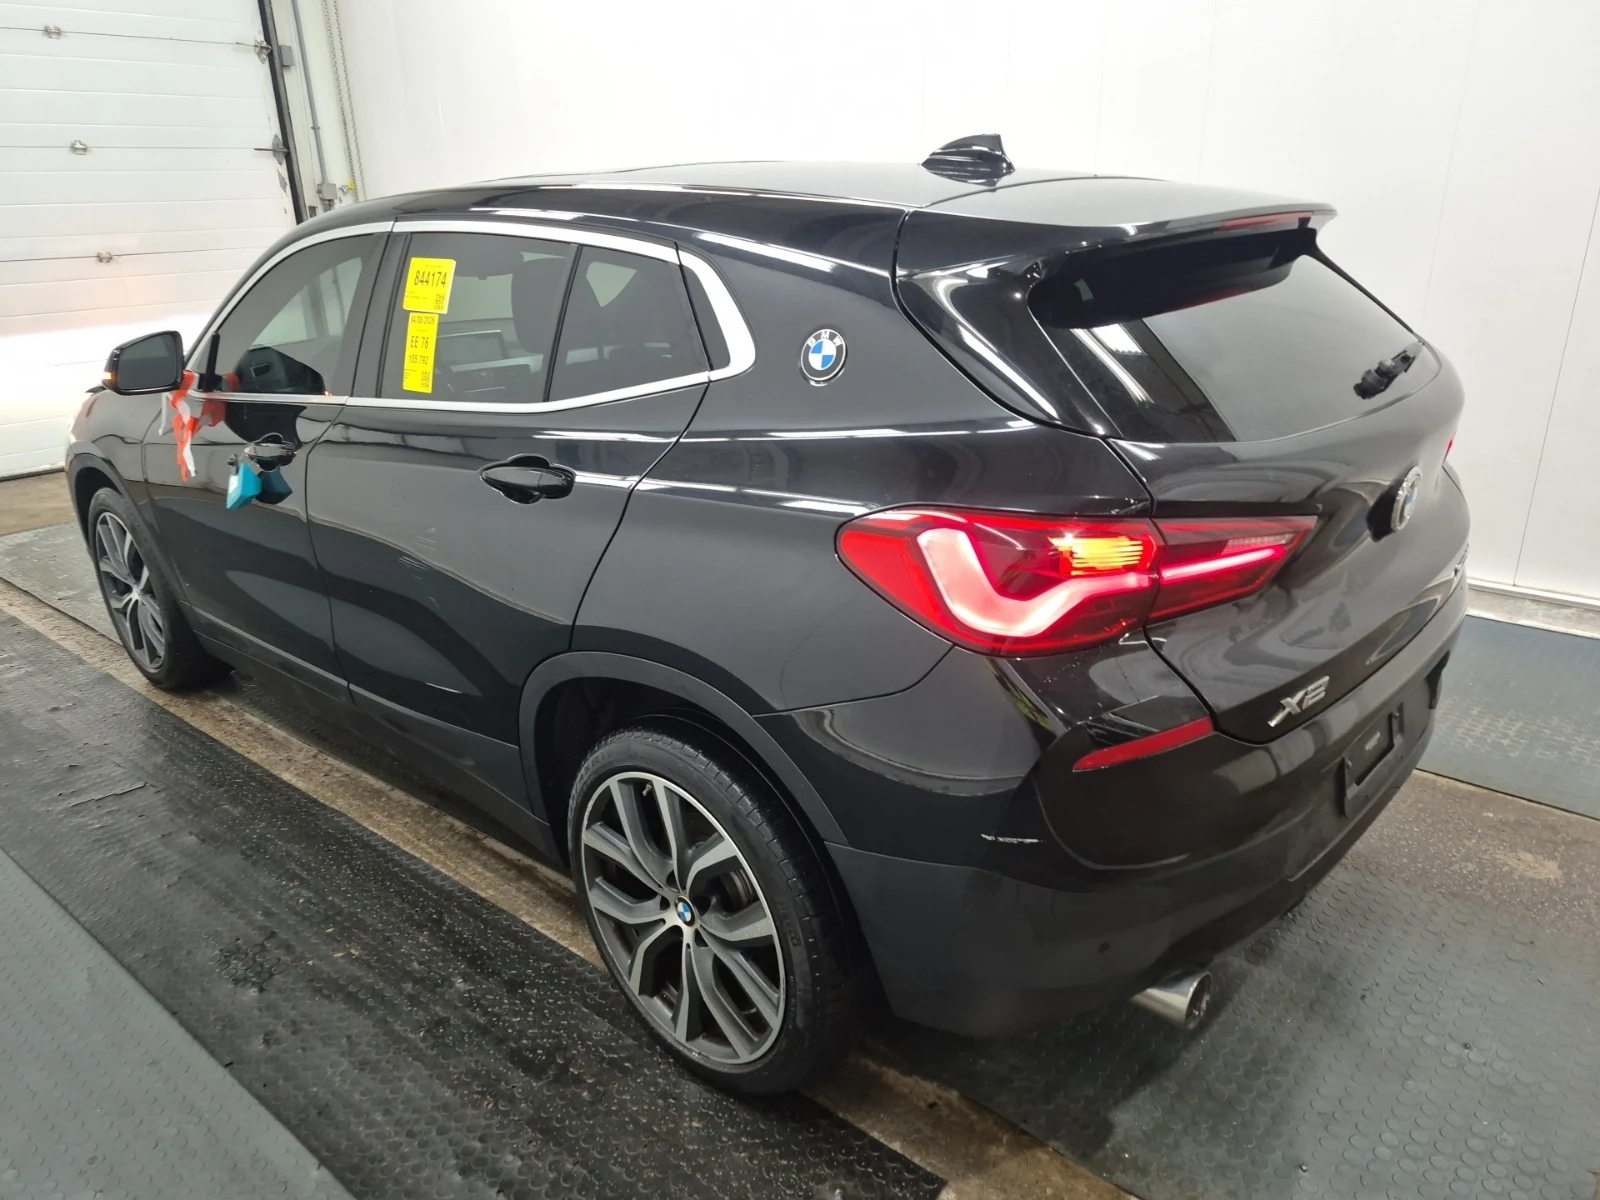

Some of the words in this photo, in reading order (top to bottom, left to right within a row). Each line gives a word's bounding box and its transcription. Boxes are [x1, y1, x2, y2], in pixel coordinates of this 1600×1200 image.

[414, 270, 447, 287] 844174
[410, 335, 419, 348] EE
[420, 336, 430, 349] 76
[1267, 675, 1330, 727] X2
